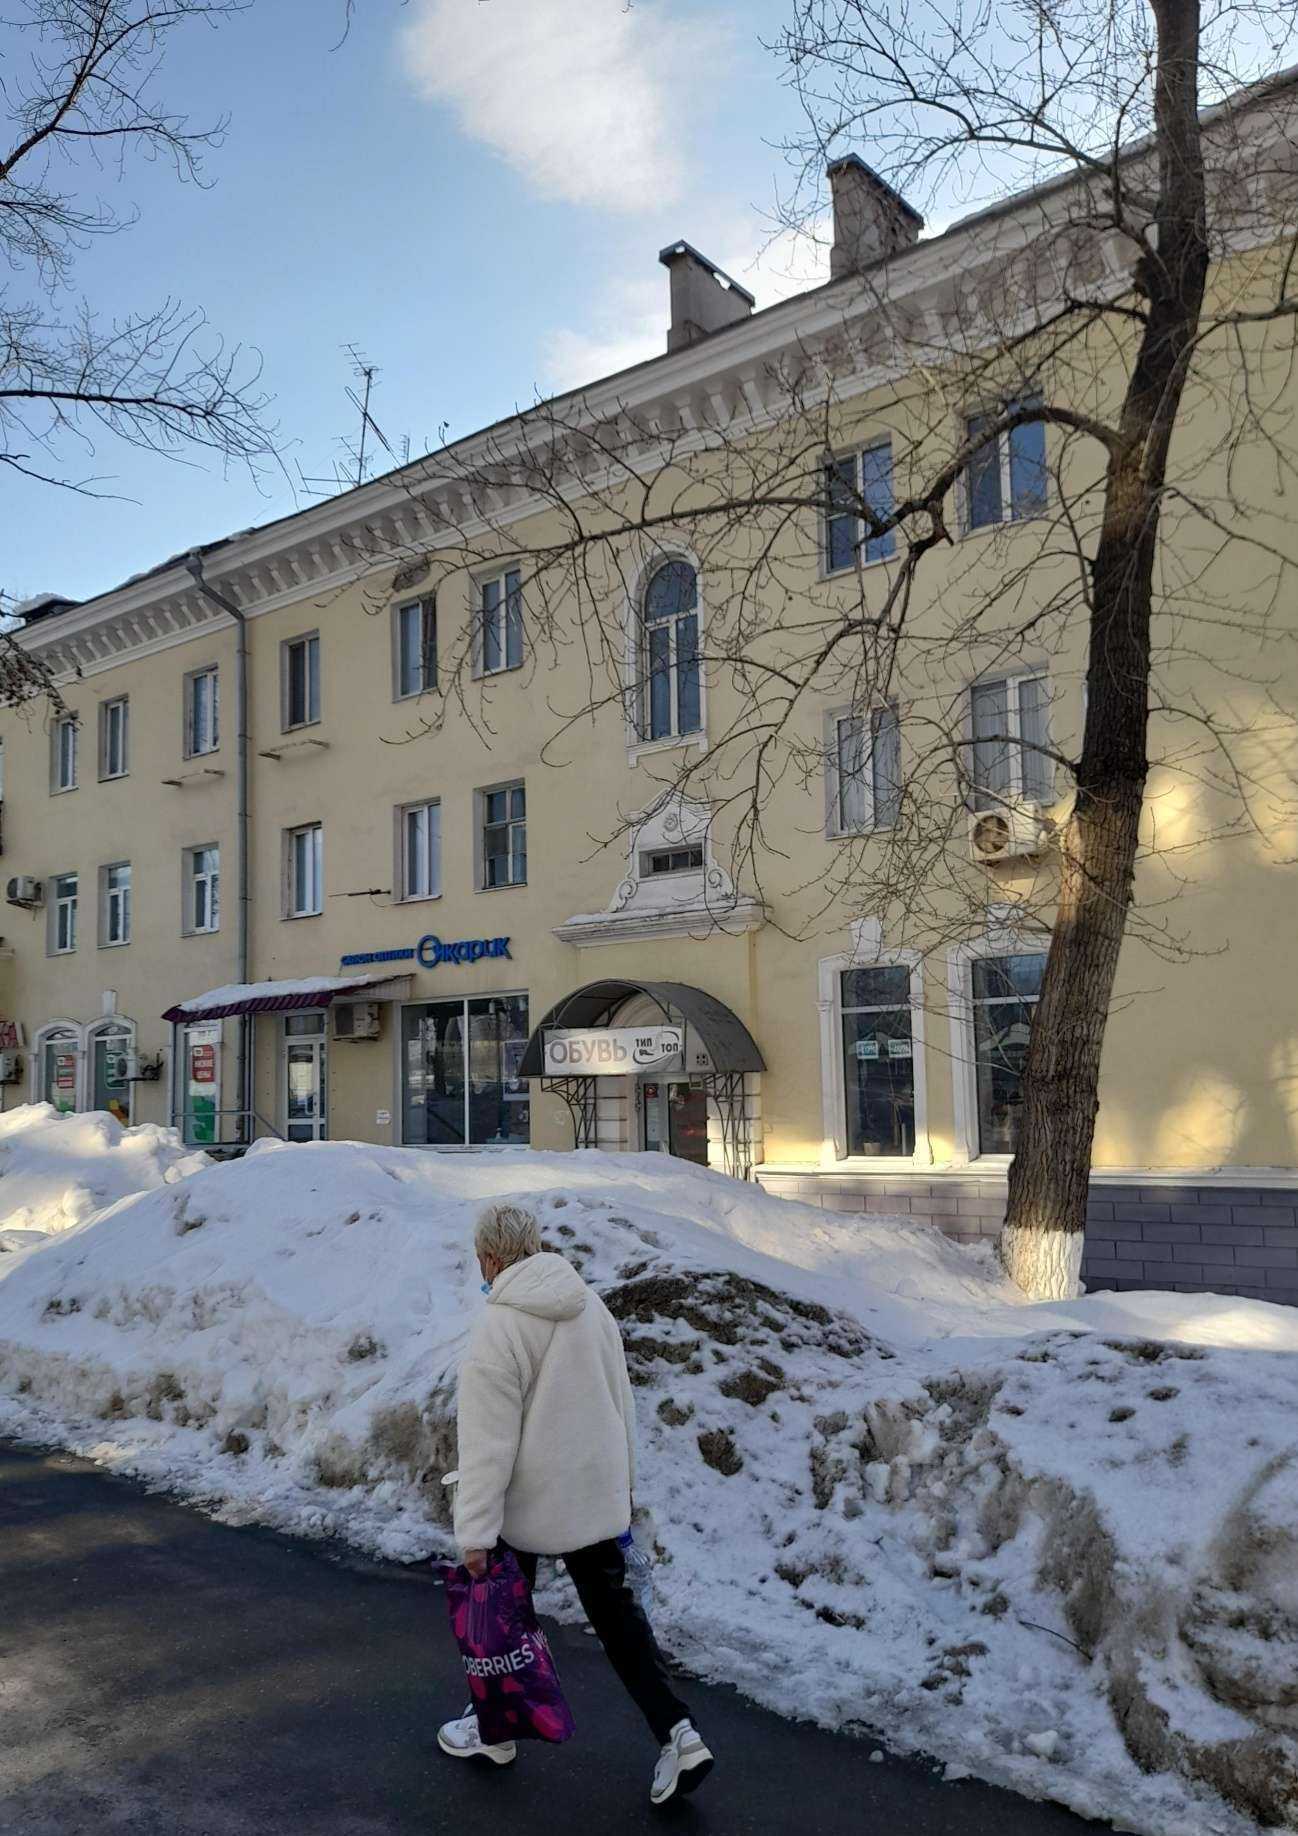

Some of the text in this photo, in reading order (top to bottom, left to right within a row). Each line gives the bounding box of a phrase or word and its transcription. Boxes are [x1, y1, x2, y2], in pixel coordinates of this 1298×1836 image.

[635, 1037, 653, 1048] ТИП
[661, 1042, 679, 1053] ТОП
[549, 1038, 628, 1064] ОБУВЬ
